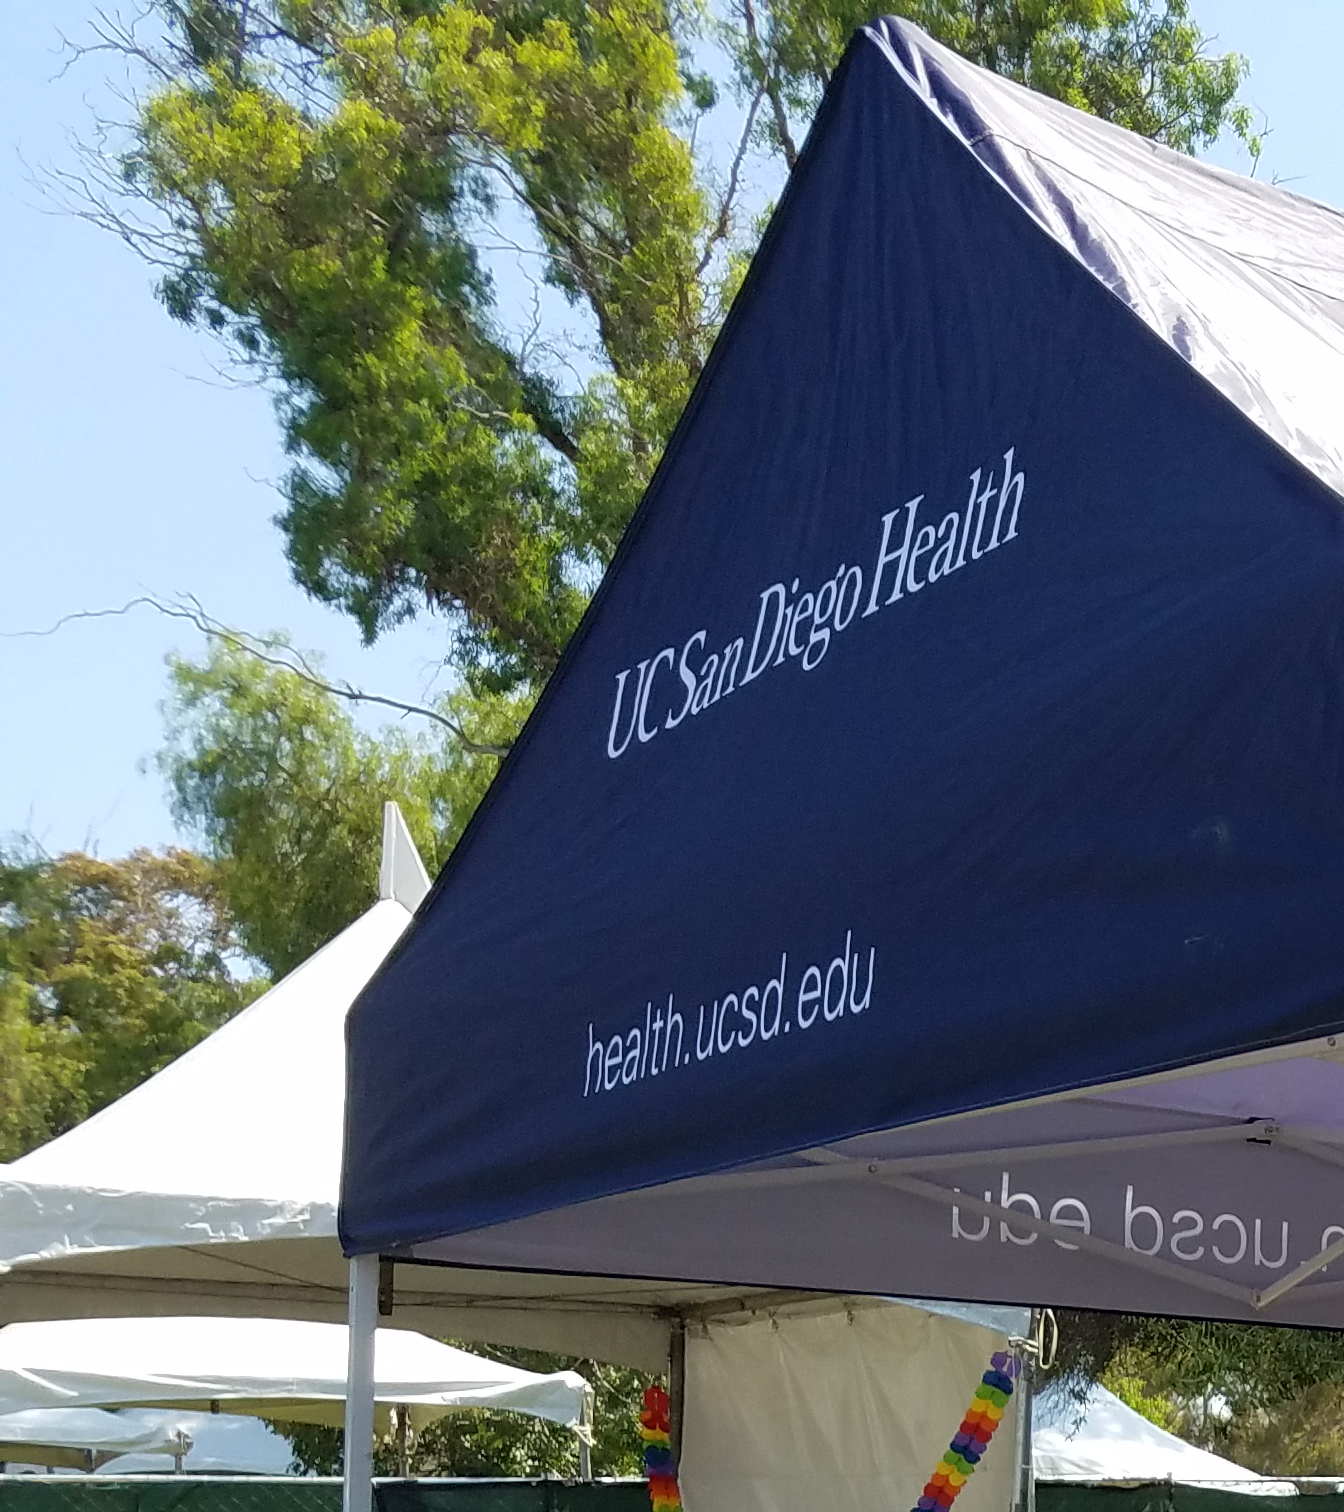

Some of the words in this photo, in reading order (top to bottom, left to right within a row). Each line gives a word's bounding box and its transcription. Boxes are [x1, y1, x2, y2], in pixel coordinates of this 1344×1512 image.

[606, 647, 678, 758] UC
[665, 629, 744, 730] San
[739, 561, 865, 671] Diego
[861, 446, 1027, 618] Health
[582, 929, 877, 1098] health.ucsd.edu
